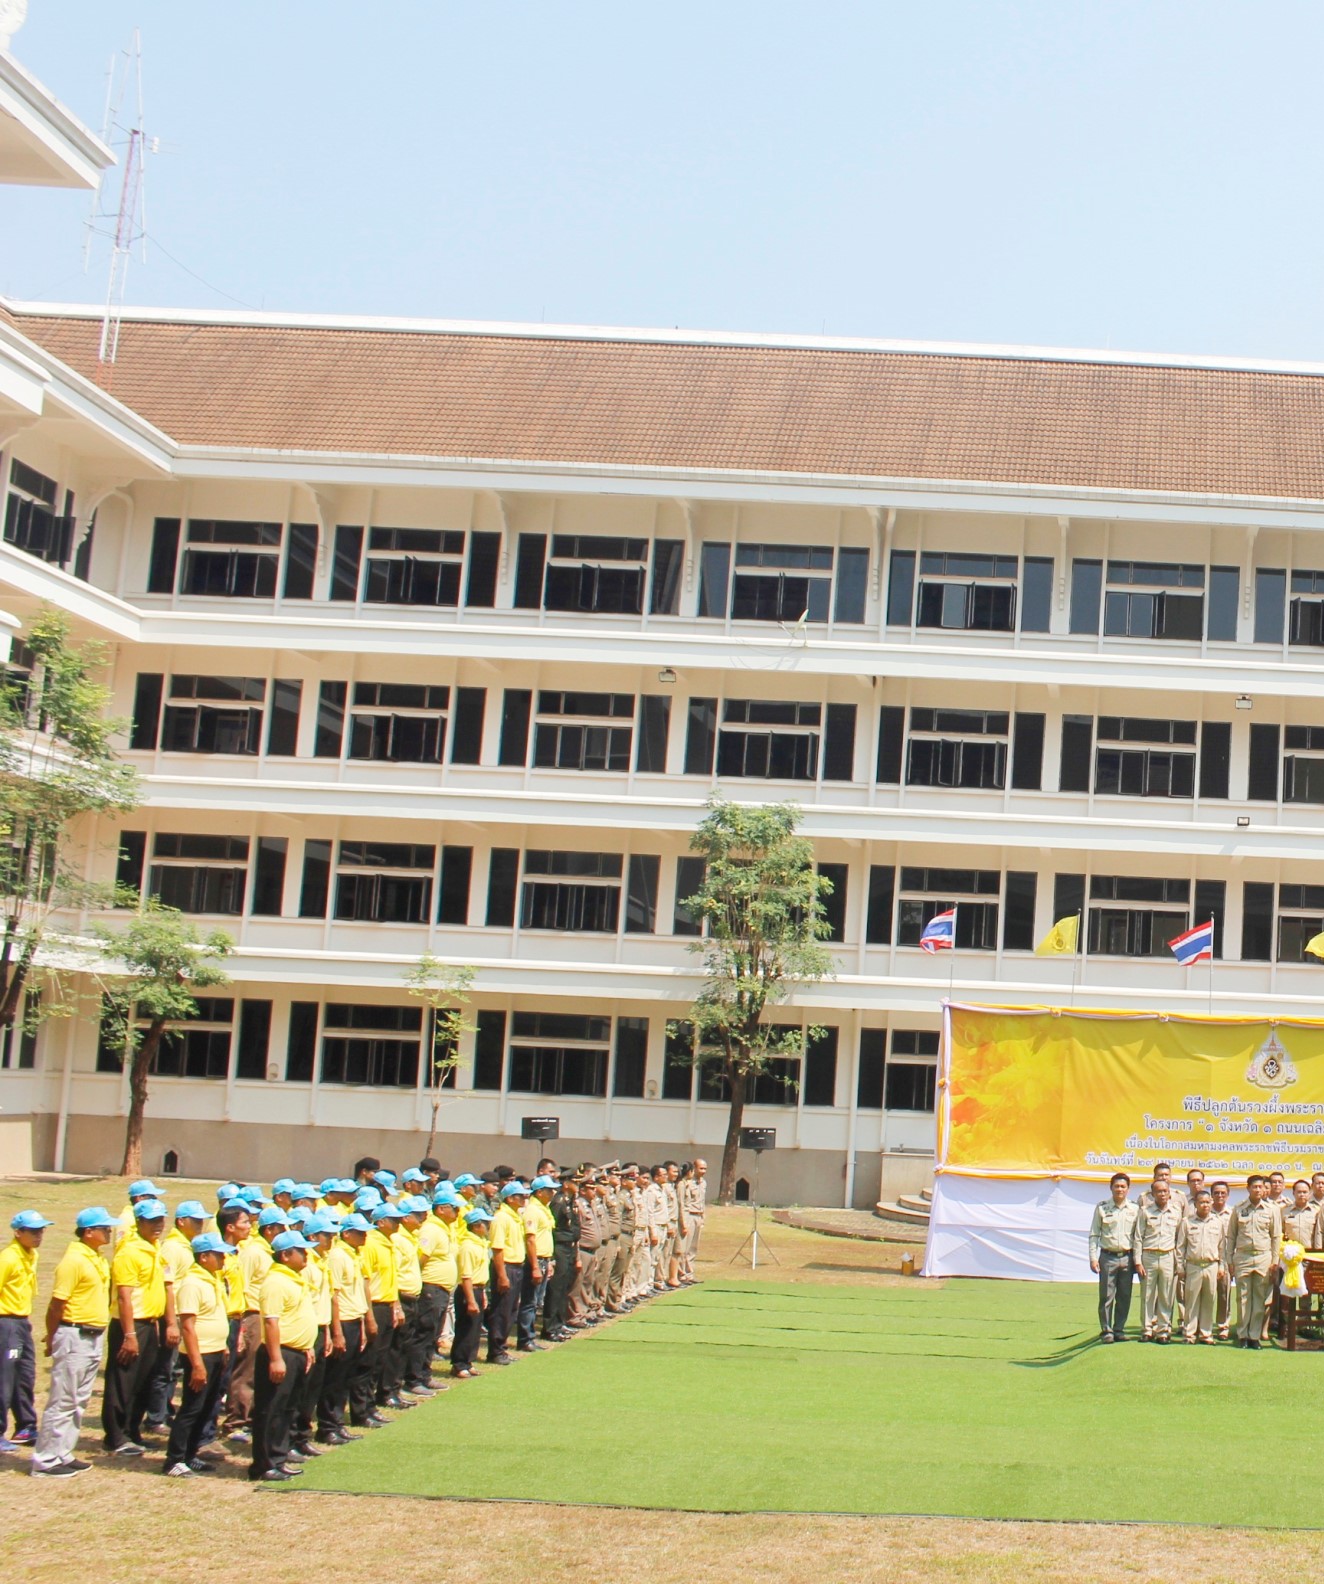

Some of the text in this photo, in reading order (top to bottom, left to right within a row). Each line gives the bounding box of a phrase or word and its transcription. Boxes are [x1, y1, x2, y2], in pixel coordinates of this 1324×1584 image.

[1144, 1115, 1192, 1130] โครงการ
[1220, 1118, 1258, 1132] จังหวัด
[1086, 1150, 1134, 1166] วันจันทร์ที่
[1232, 1160, 1254, 1169] เวลา
